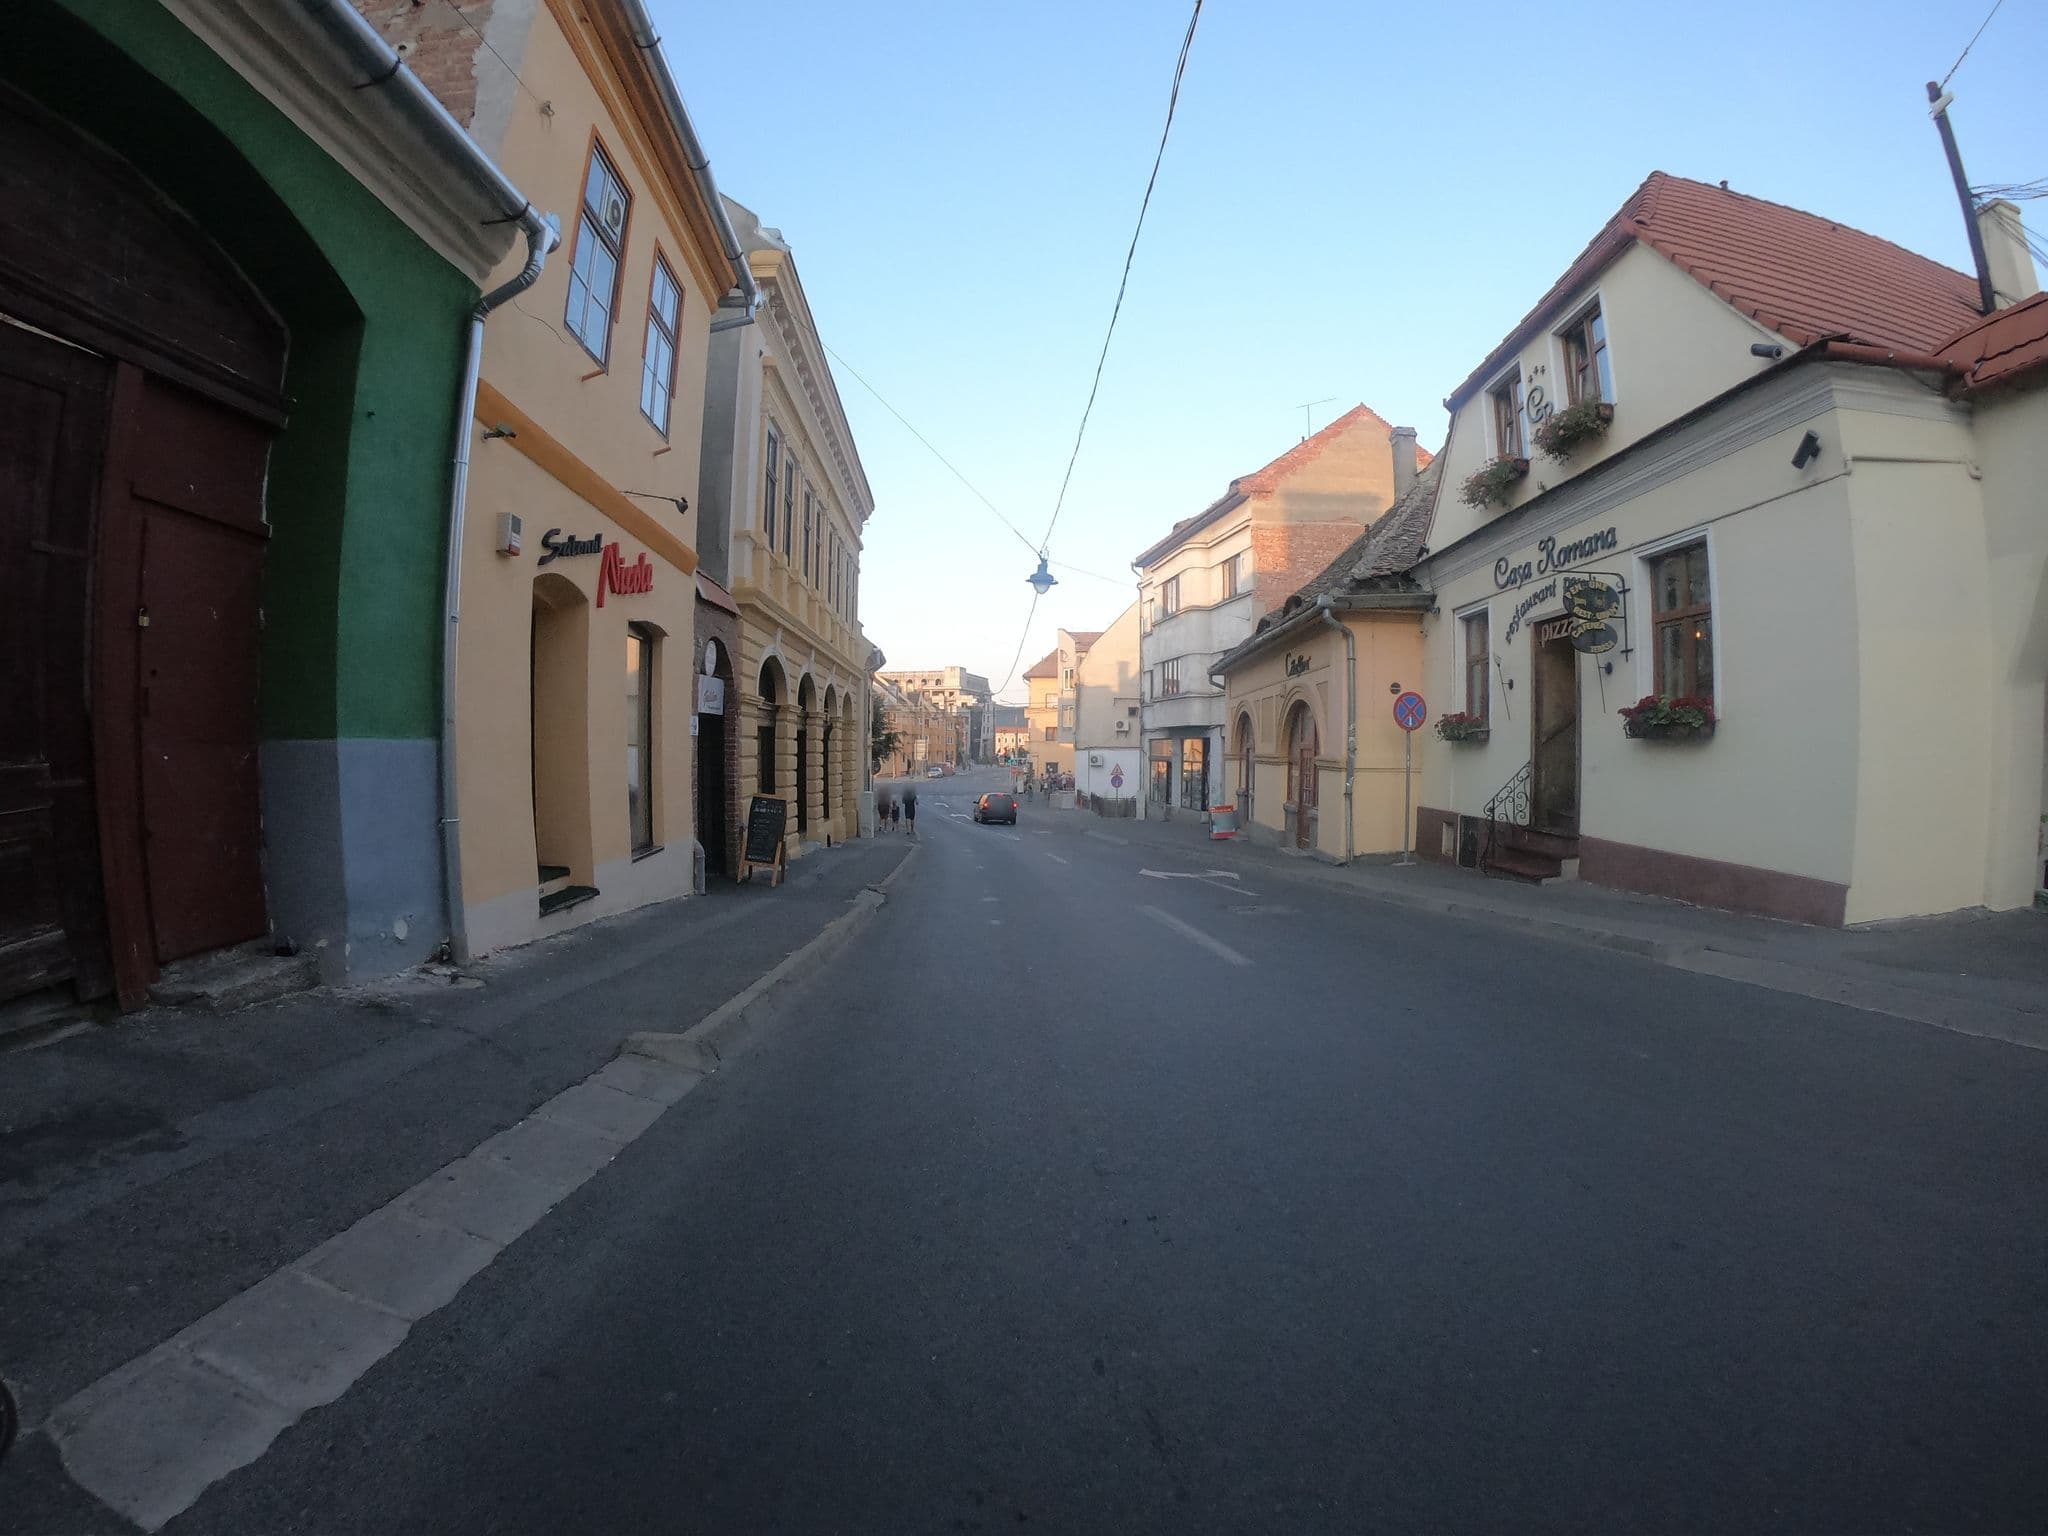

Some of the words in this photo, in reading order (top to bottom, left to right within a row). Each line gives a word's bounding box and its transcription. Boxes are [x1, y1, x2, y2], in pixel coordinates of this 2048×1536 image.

[596, 542, 654, 609] Nicole
[1494, 556, 1533, 590] Casa
[1537, 526, 1618, 575] Romana
[1565, 580, 1608, 599] PENUNE
[1505, 578, 1557, 645] restaurant
